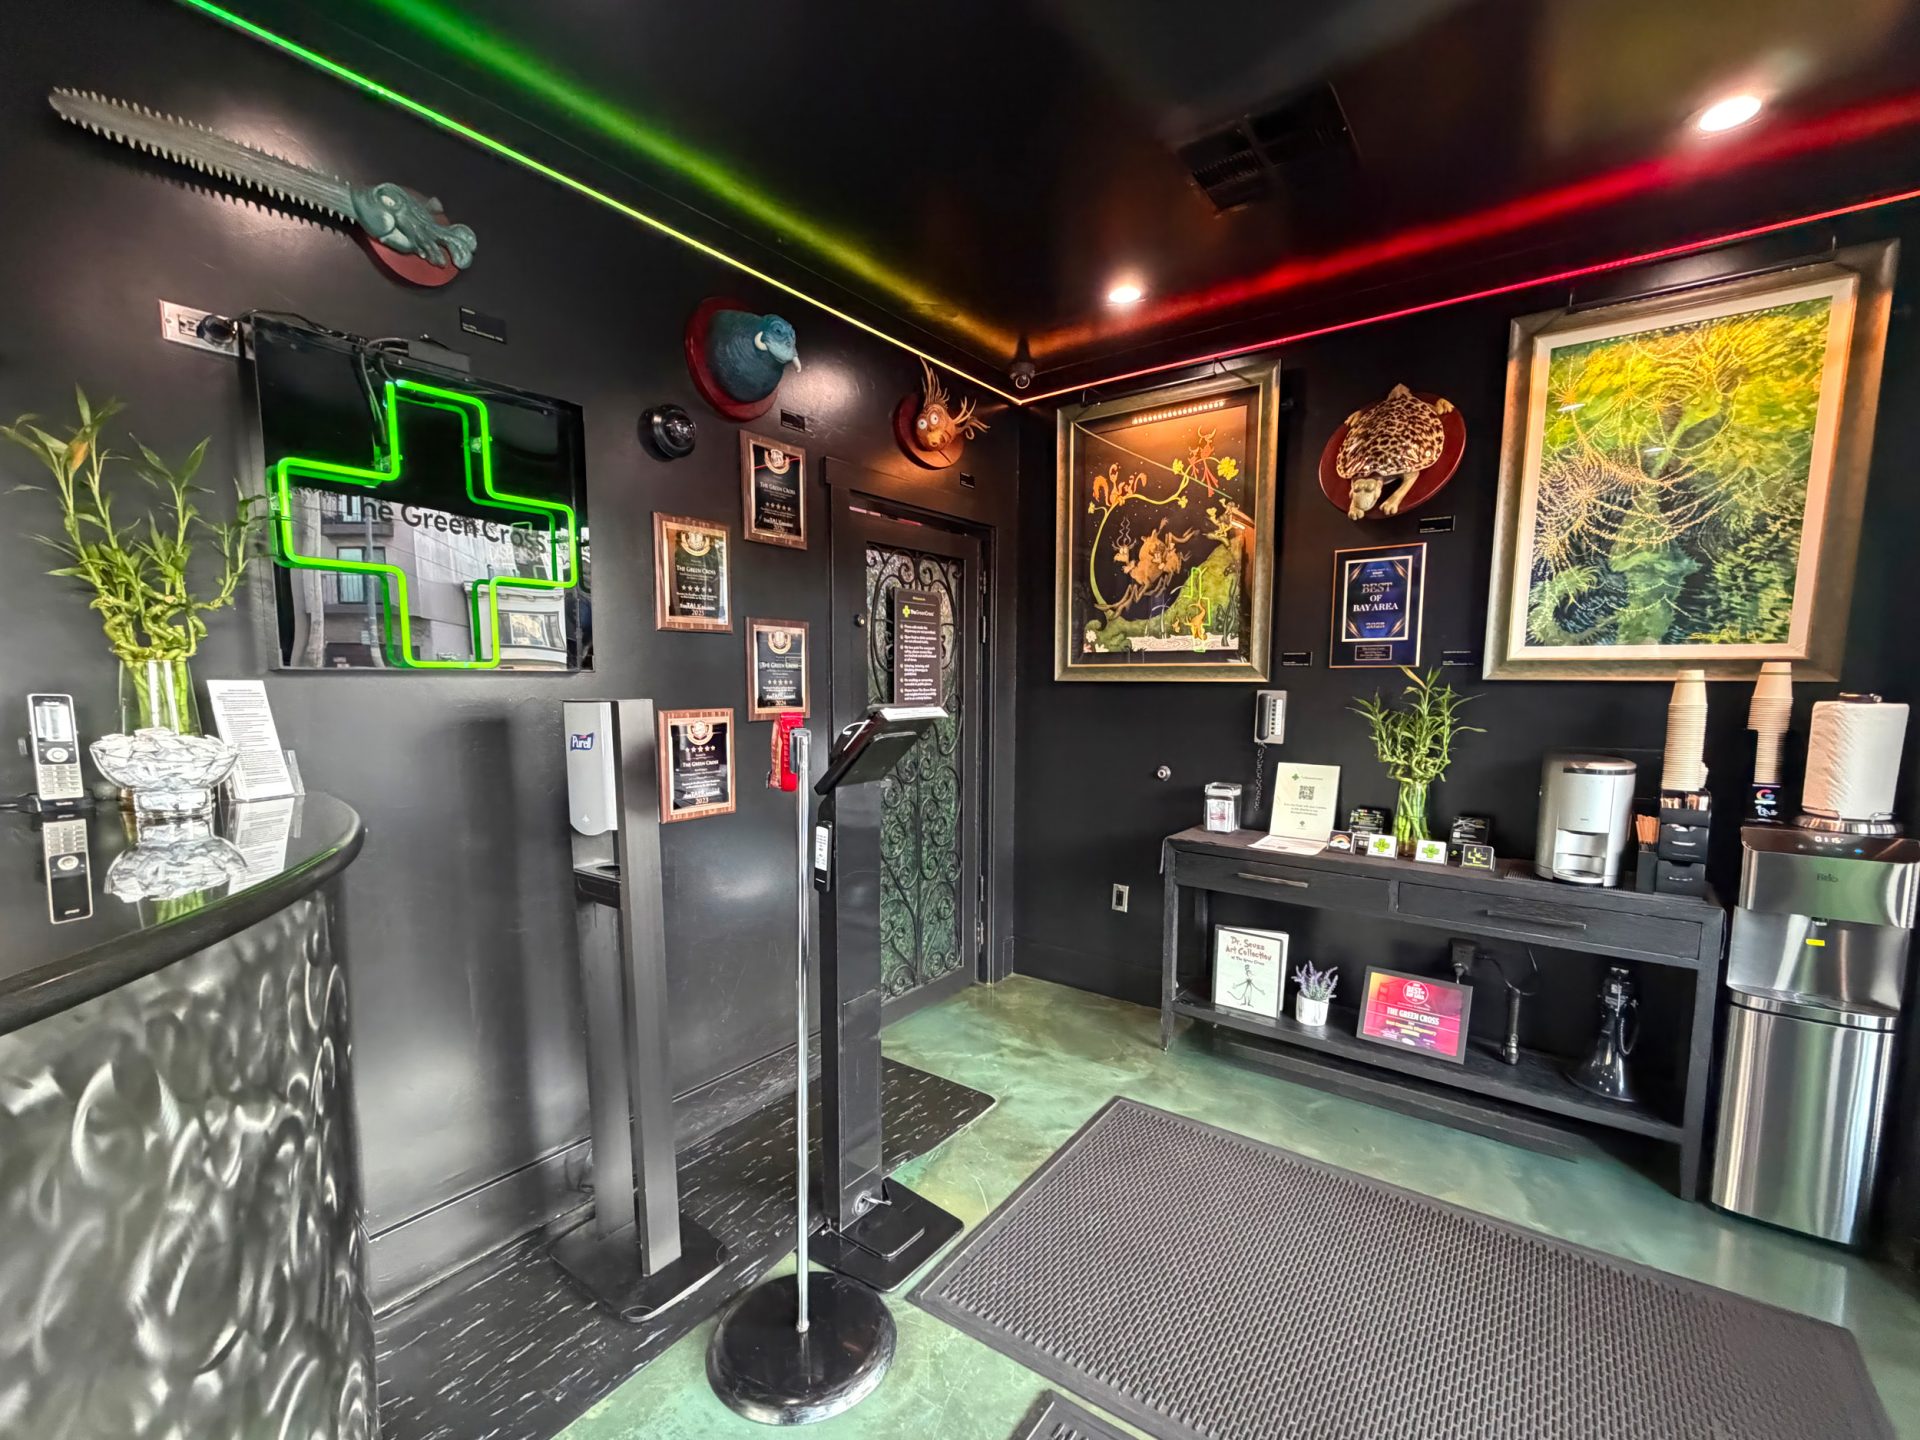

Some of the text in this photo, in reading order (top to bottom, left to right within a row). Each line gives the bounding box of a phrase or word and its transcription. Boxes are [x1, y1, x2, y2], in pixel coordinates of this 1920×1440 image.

[401, 505, 478, 538] Green
[482, 519, 547, 554] Cross
[1361, 582, 1393, 594] BEST
[1369, 594, 1382, 602] OF
[1353, 602, 1398, 612] BAY AREA
[1231, 936, 1265, 950] Dr. Seuss
[1226, 945, 1272, 961] Art Collection
[1387, 1006, 1399, 1016] THE
[1399, 1009, 1419, 1021] GREEN
[1420, 1014, 1440, 1025] CROSS
